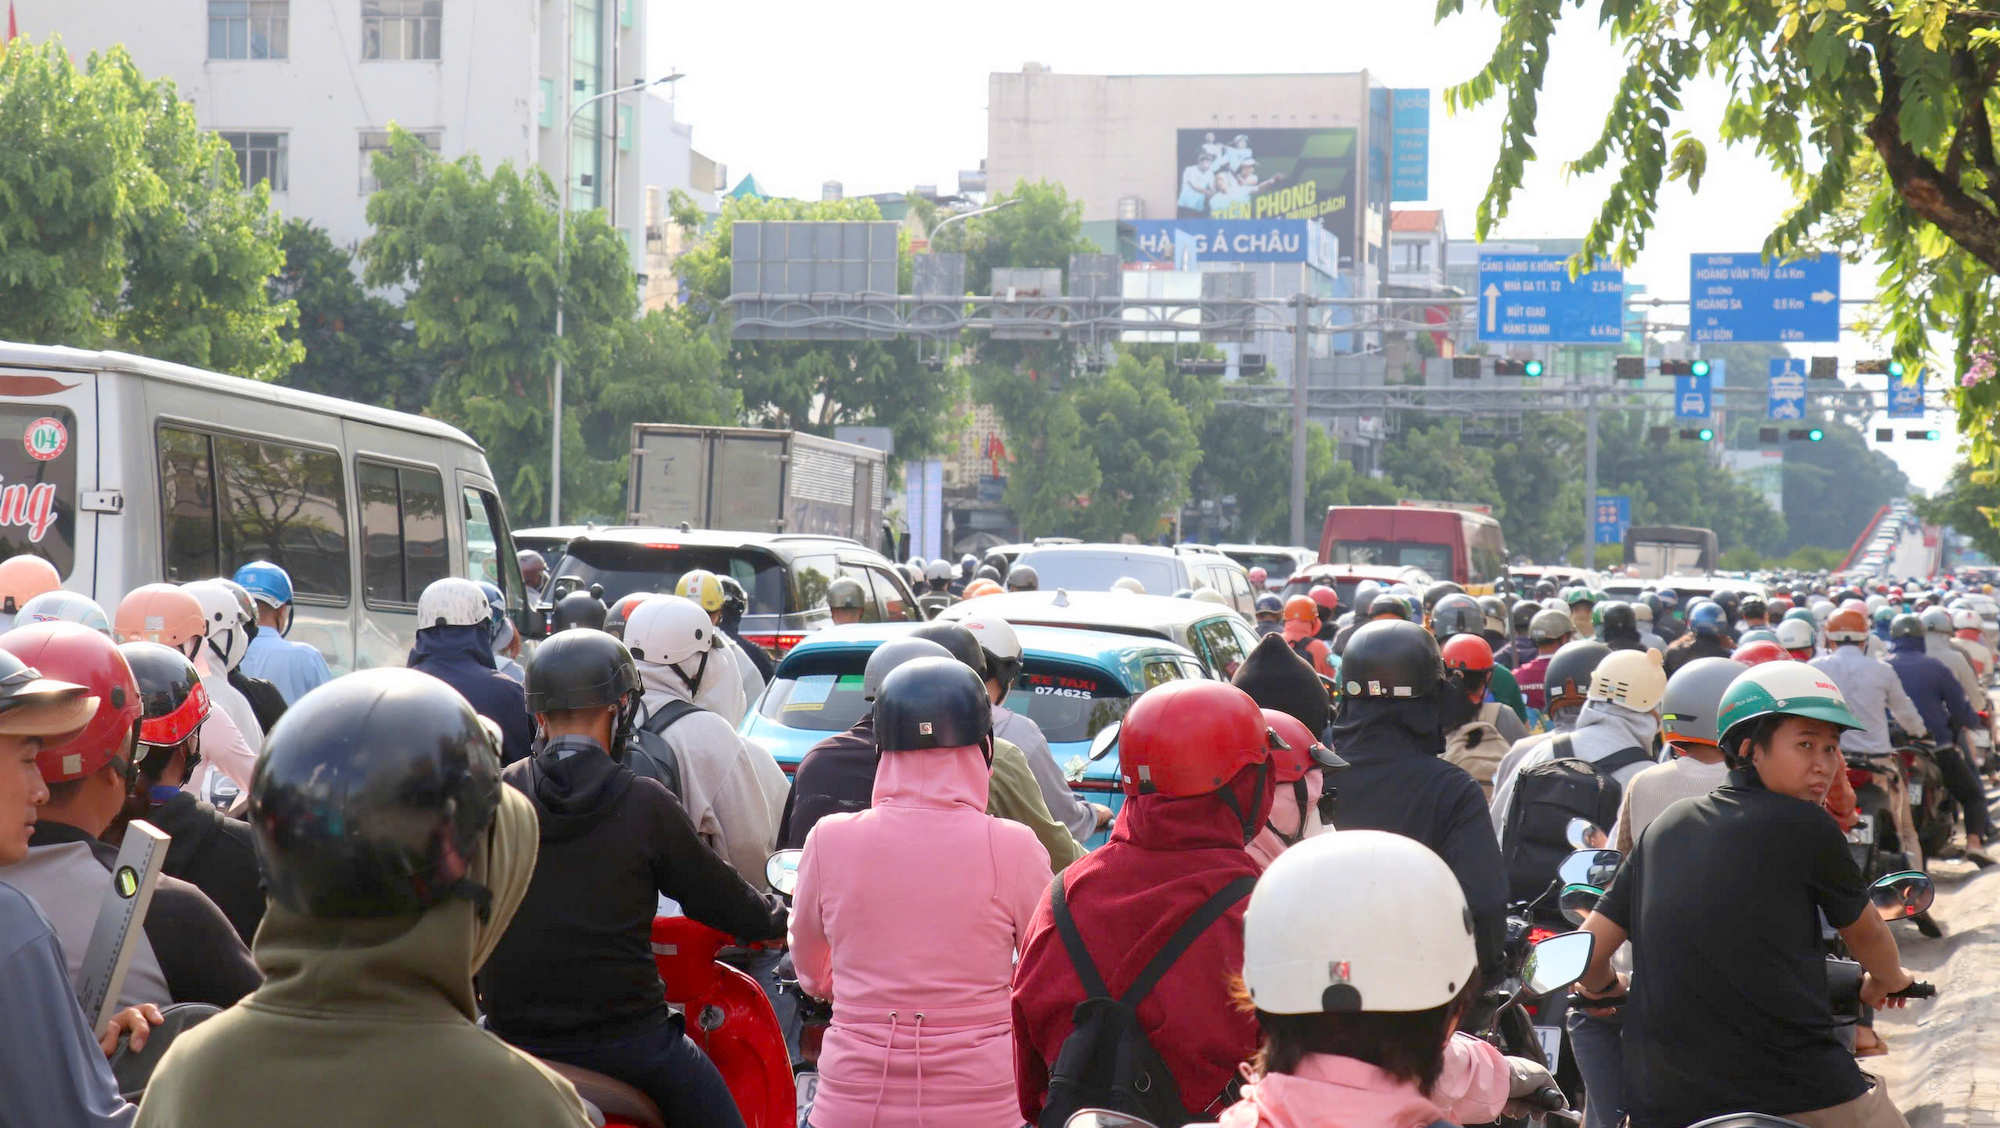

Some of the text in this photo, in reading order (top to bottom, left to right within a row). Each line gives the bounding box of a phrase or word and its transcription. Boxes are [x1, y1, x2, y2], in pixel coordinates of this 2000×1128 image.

[1255, 180, 1317, 219] PHONG
[1140, 228, 1300, 253] HÀG Á CHÂU
[1696, 266, 1728, 279] HOÀNG
[1789, 269, 1805, 279] Km
[1523, 281, 1535, 292] GA
[1608, 281, 1622, 292] Km
[1730, 299, 1742, 310] SA
[1789, 299, 1804, 310] Km
[1526, 307, 1546, 317] GIAO
[1606, 325, 1620, 336] Km
[1788, 330, 1804, 340] Km
[34, 428, 58, 449] 04
[1029, 673, 1097, 691] XE TAXI
[1035, 686, 1092, 700] 07462S
